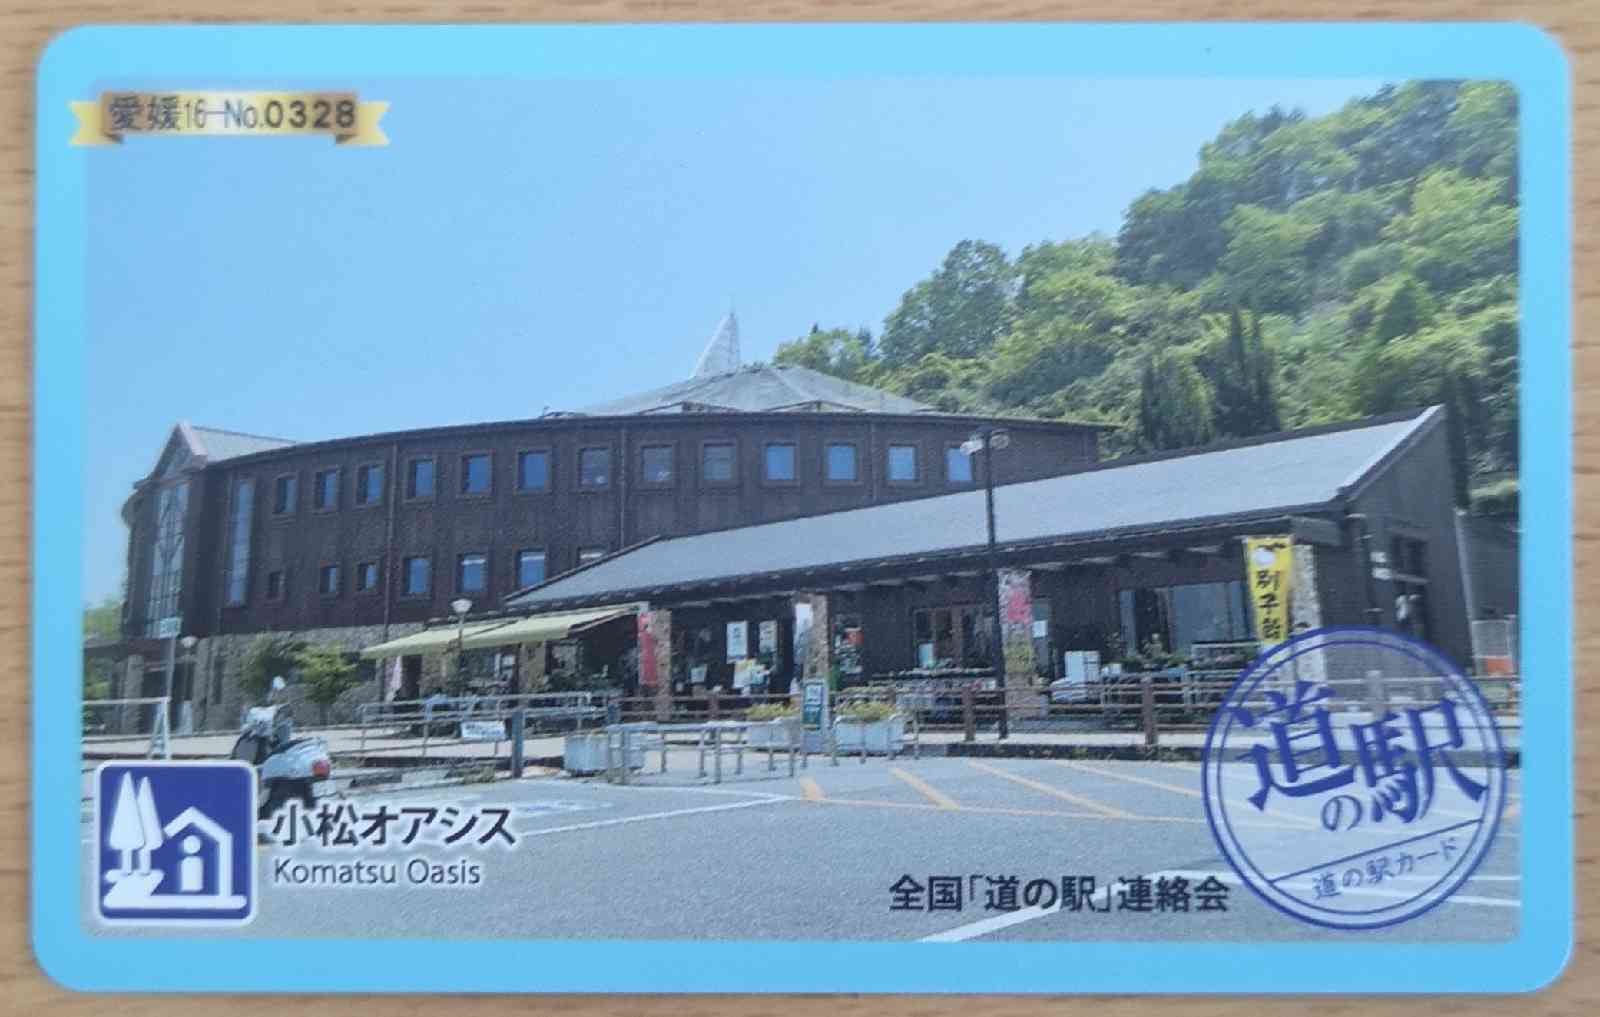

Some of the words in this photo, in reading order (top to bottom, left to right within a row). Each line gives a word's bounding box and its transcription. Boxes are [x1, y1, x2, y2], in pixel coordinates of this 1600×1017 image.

[271, 803, 516, 847] 小松オアシス
[273, 858, 397, 884] Komatsu
[406, 858, 481, 884] Oasis
[1312, 837, 1459, 900] 道の駅カード
[888, 874, 1231, 912] 全国「道の駅」連絡会
